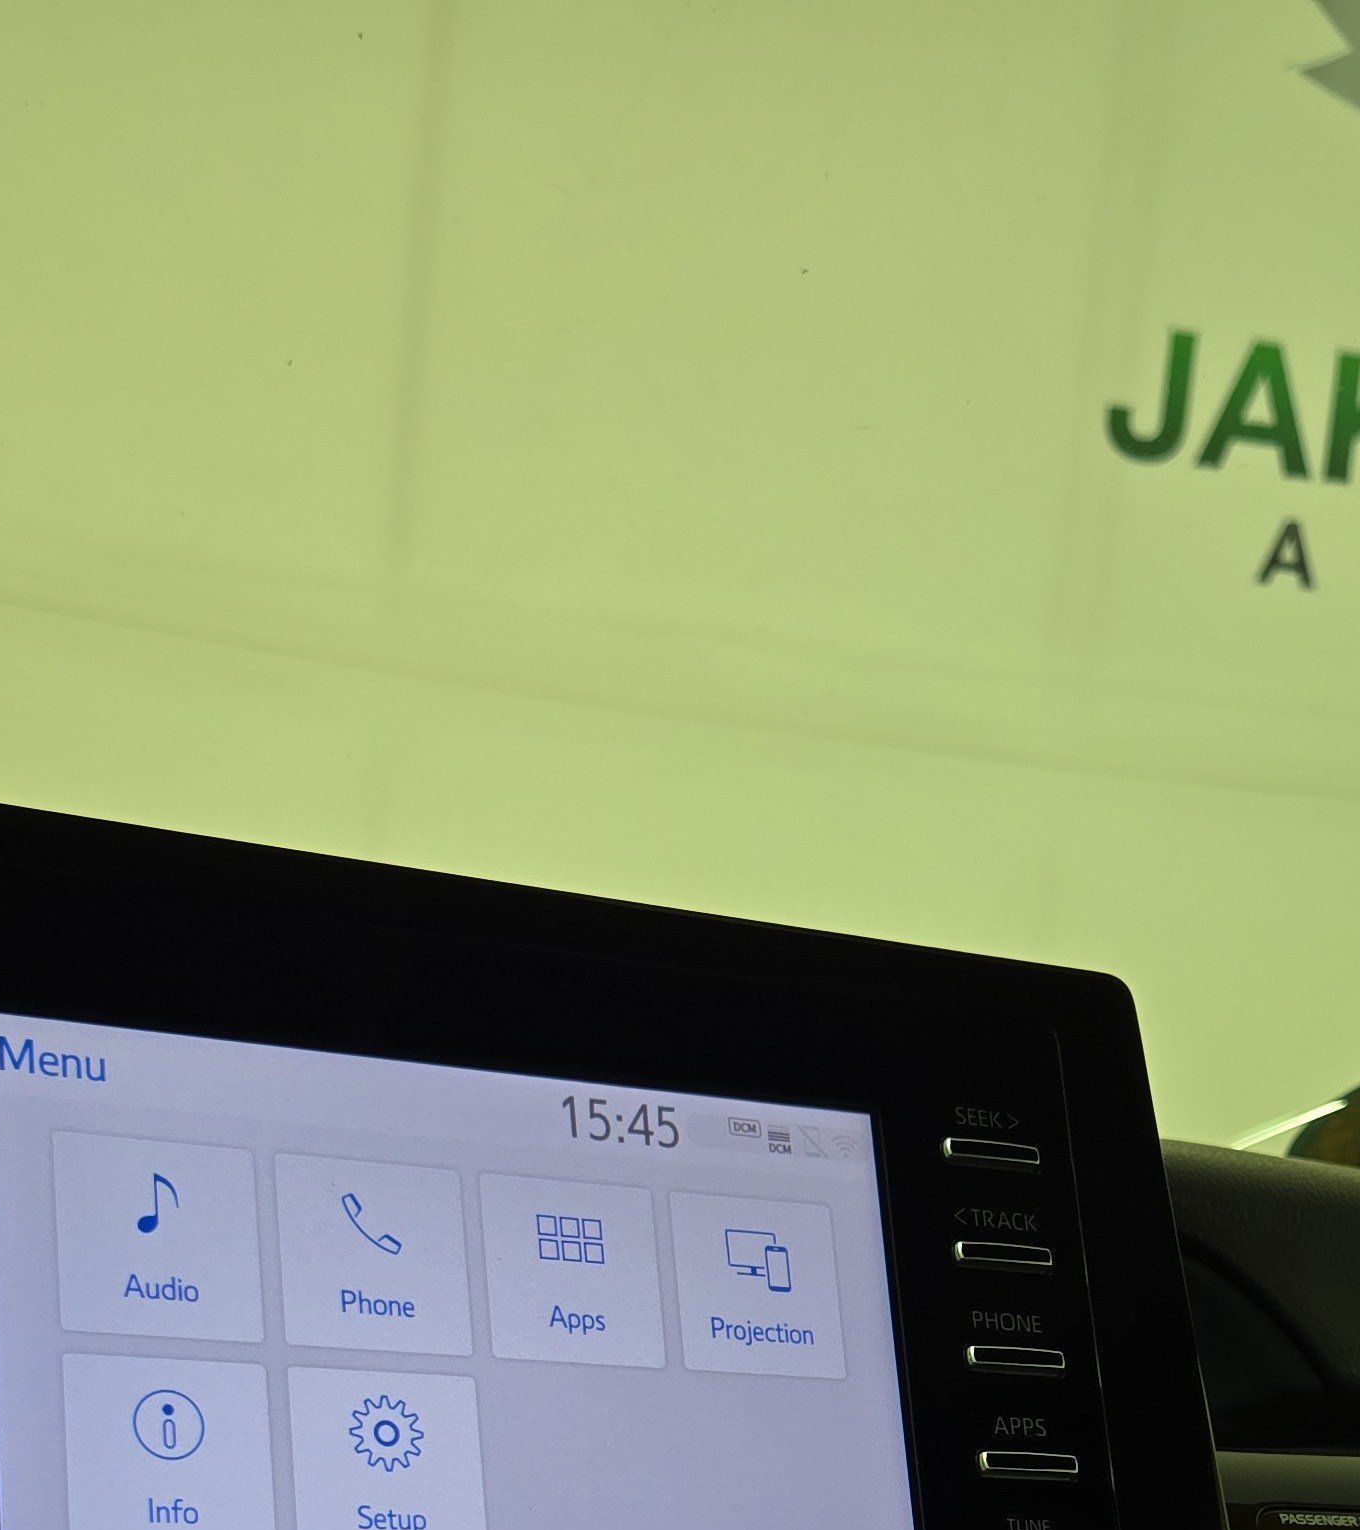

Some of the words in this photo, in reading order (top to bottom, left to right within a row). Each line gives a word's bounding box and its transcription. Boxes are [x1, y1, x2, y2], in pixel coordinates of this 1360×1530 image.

[561, 1095, 680, 1148] 15:45
[733, 1122, 757, 1133] DCM
[955, 1106, 1002, 1129] SEEK
[768, 1143, 792, 1154] DCM
[124, 1274, 200, 1303] Audio
[340, 1290, 416, 1319] Phone
[549, 1305, 606, 1335] Apps
[710, 1316, 815, 1346] Projection
[971, 1311, 1043, 1333] PHONE
[994, 1416, 1047, 1437] APPS
[147, 1499, 199, 1525] Info
[1280, 1512, 1358, 1527] PASSENGER
